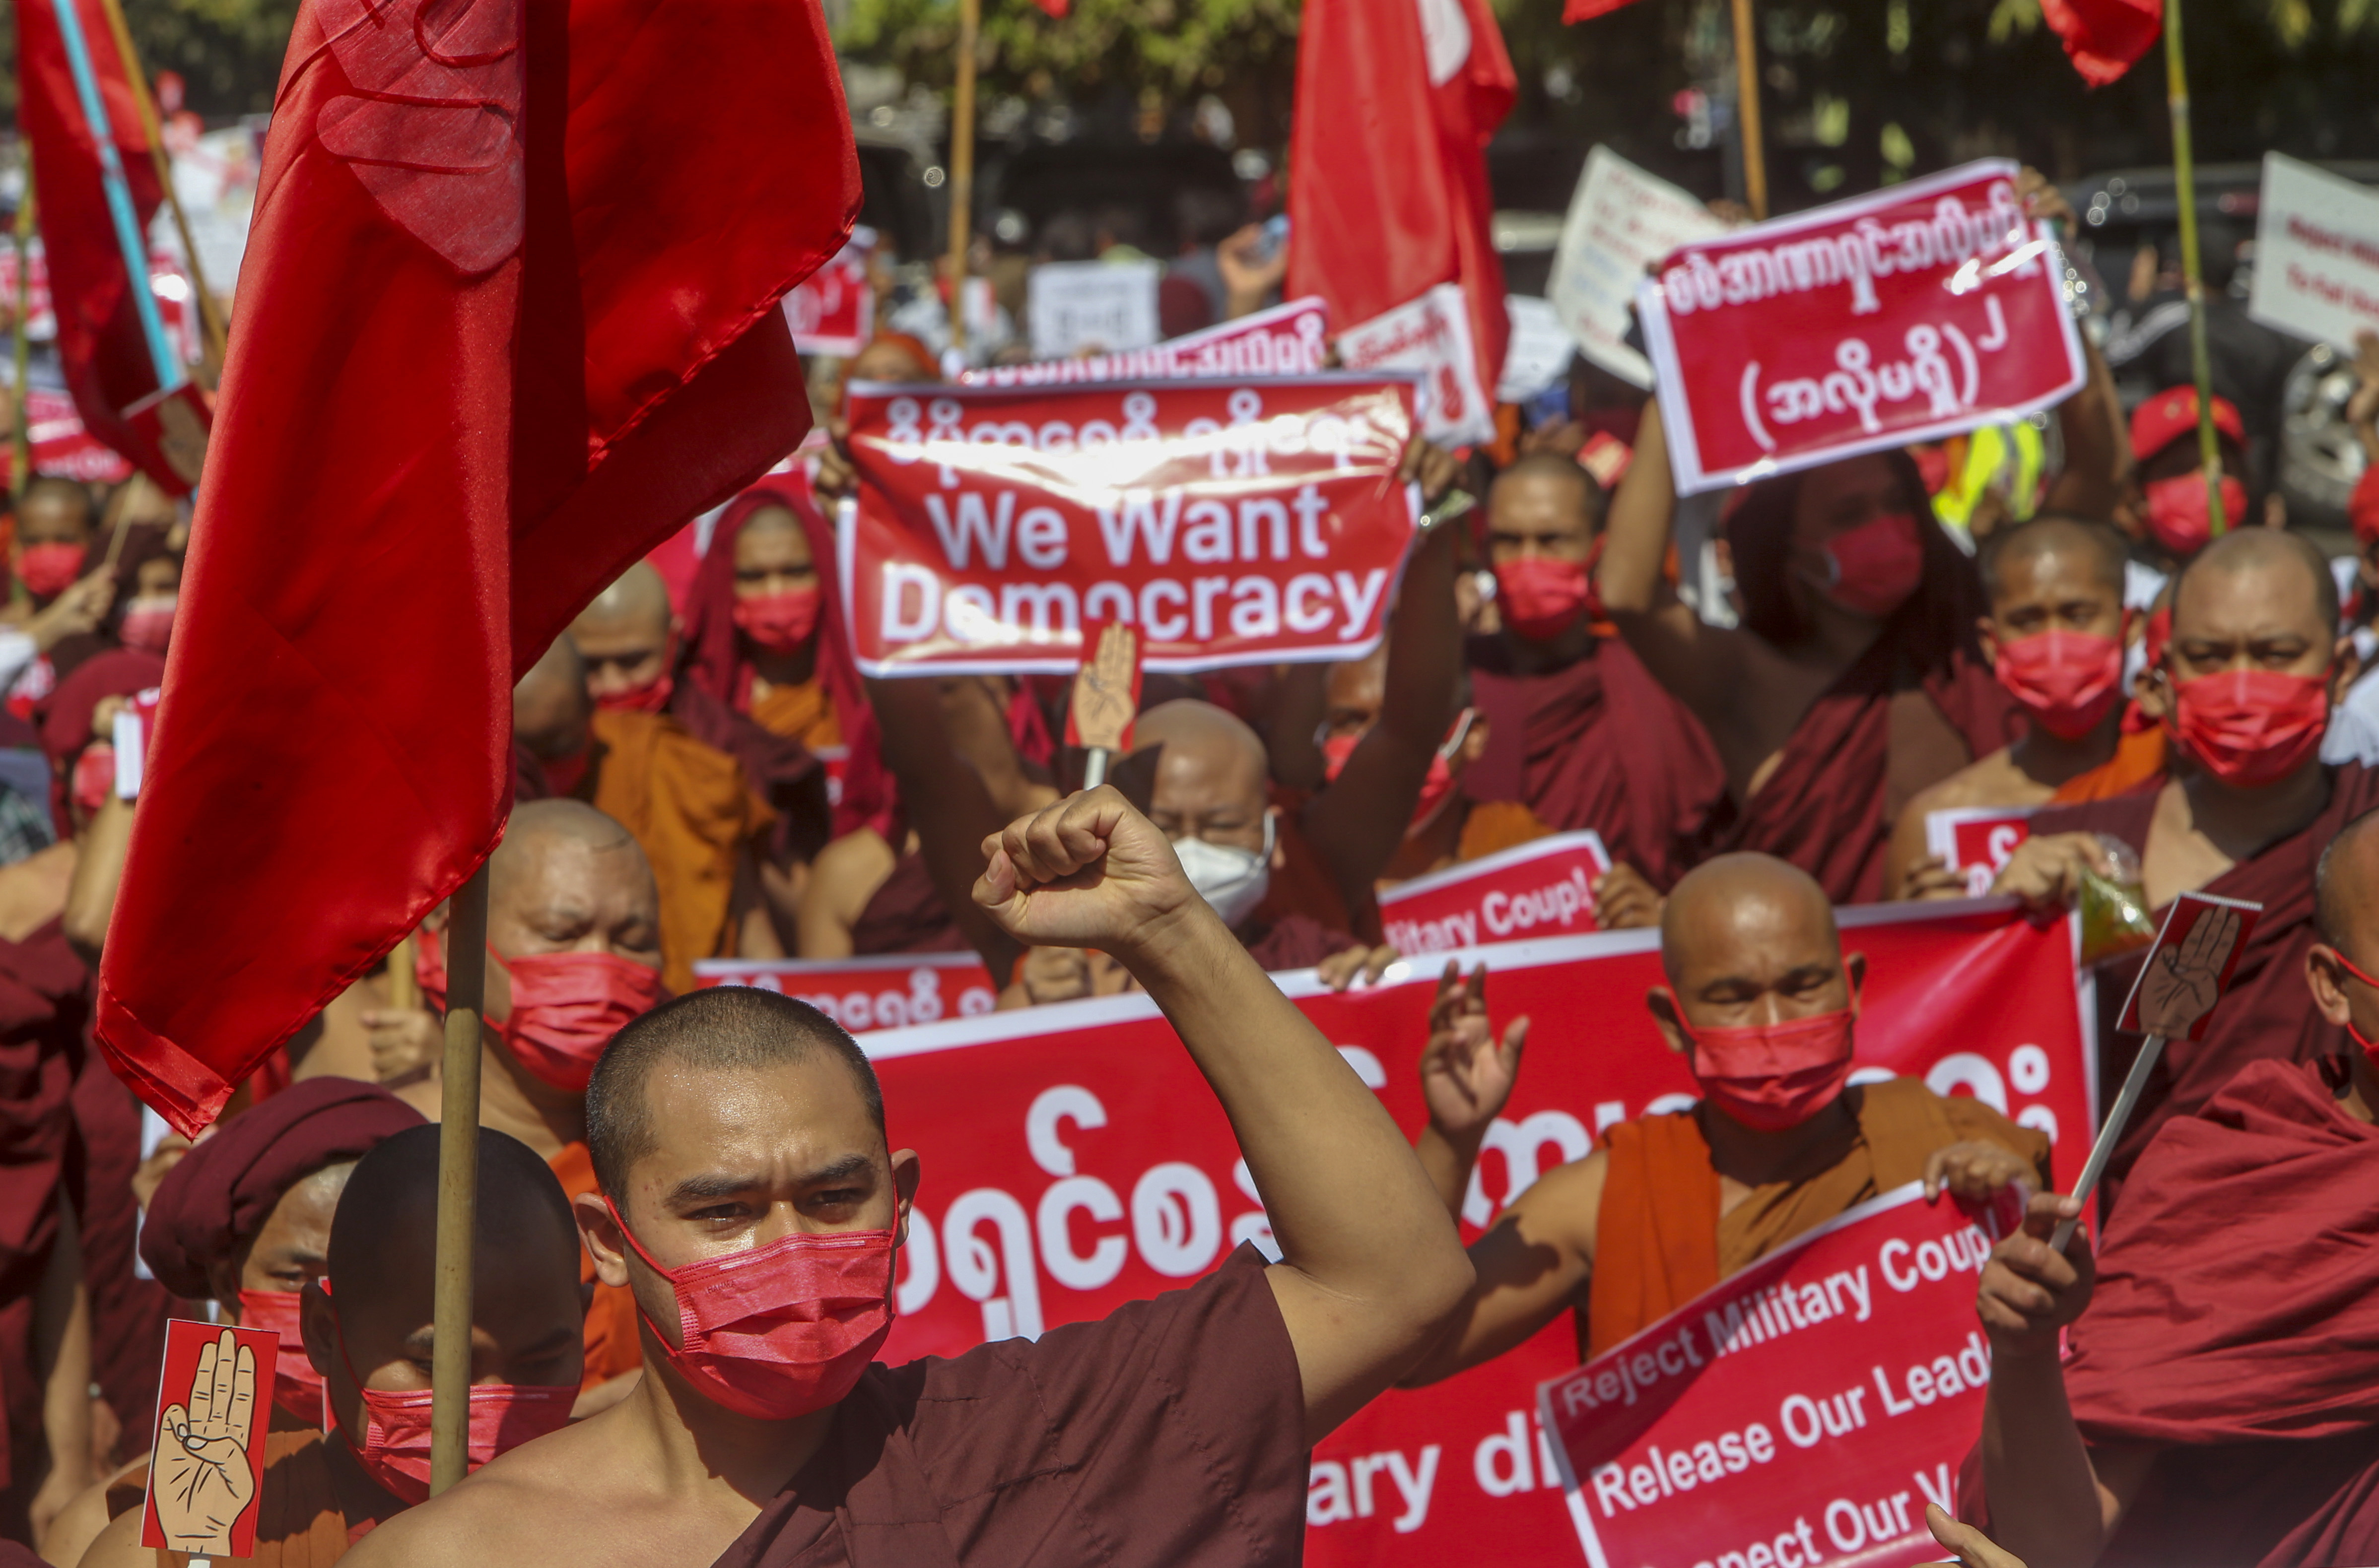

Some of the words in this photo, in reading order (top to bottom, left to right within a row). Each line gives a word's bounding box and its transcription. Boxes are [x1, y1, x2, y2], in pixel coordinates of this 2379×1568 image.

[924, 491, 1068, 571] We
[1096, 482, 1328, 566] Want
[881, 562, 1388, 643] Democracy
[1384, 910, 1478, 956] litary
[1482, 866, 1594, 935] Coup!
[1561, 1324, 1704, 1418] Reject
[1703, 1264, 1873, 1357] Military
[1591, 1421, 1776, 1518] Release
[1780, 1385, 1868, 1449] Our
[1872, 1331, 1992, 1418] Lead
[1306, 1443, 1441, 1534] ary
[1472, 1409, 1564, 1498] di
[1824, 1491, 1912, 1553] Our
